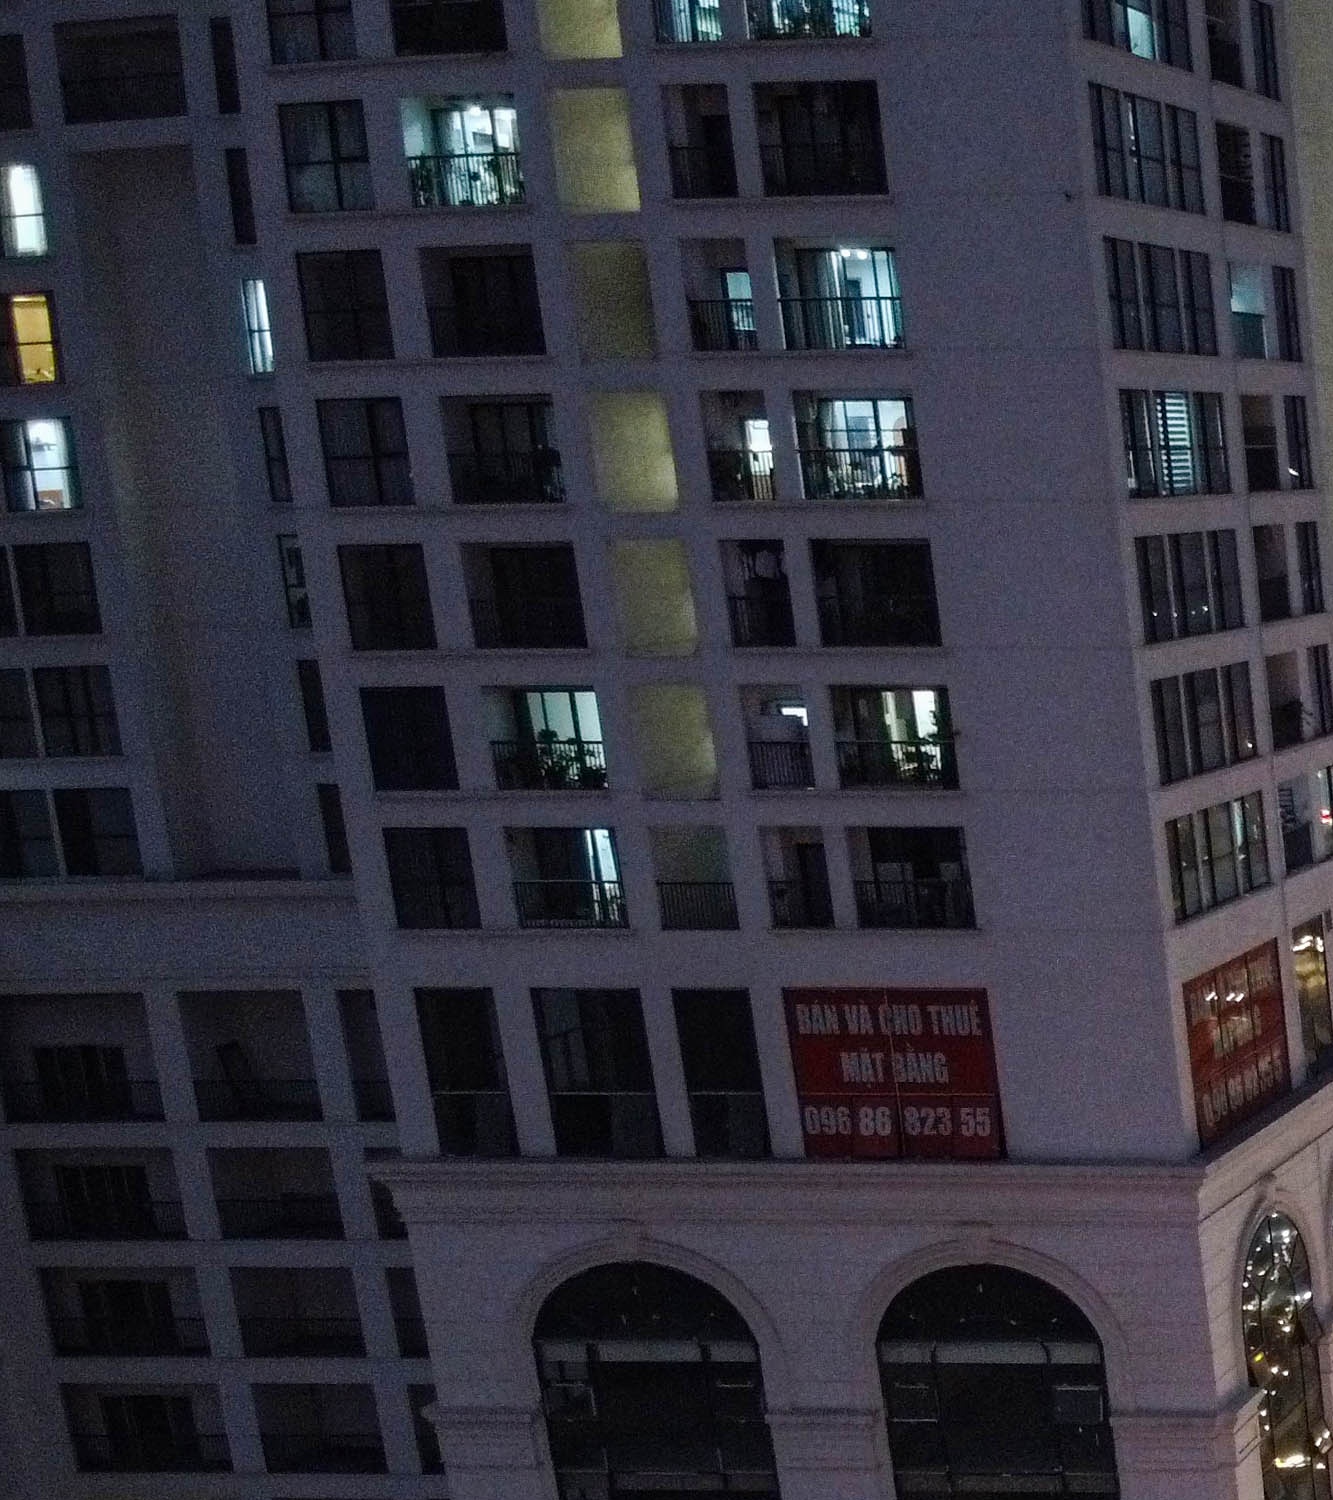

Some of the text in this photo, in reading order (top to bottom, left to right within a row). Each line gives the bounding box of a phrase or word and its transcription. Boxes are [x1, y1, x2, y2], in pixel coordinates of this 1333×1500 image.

[878, 1003, 922, 1036] CHO
[804, 1105, 991, 1137] 096 86 823 55
